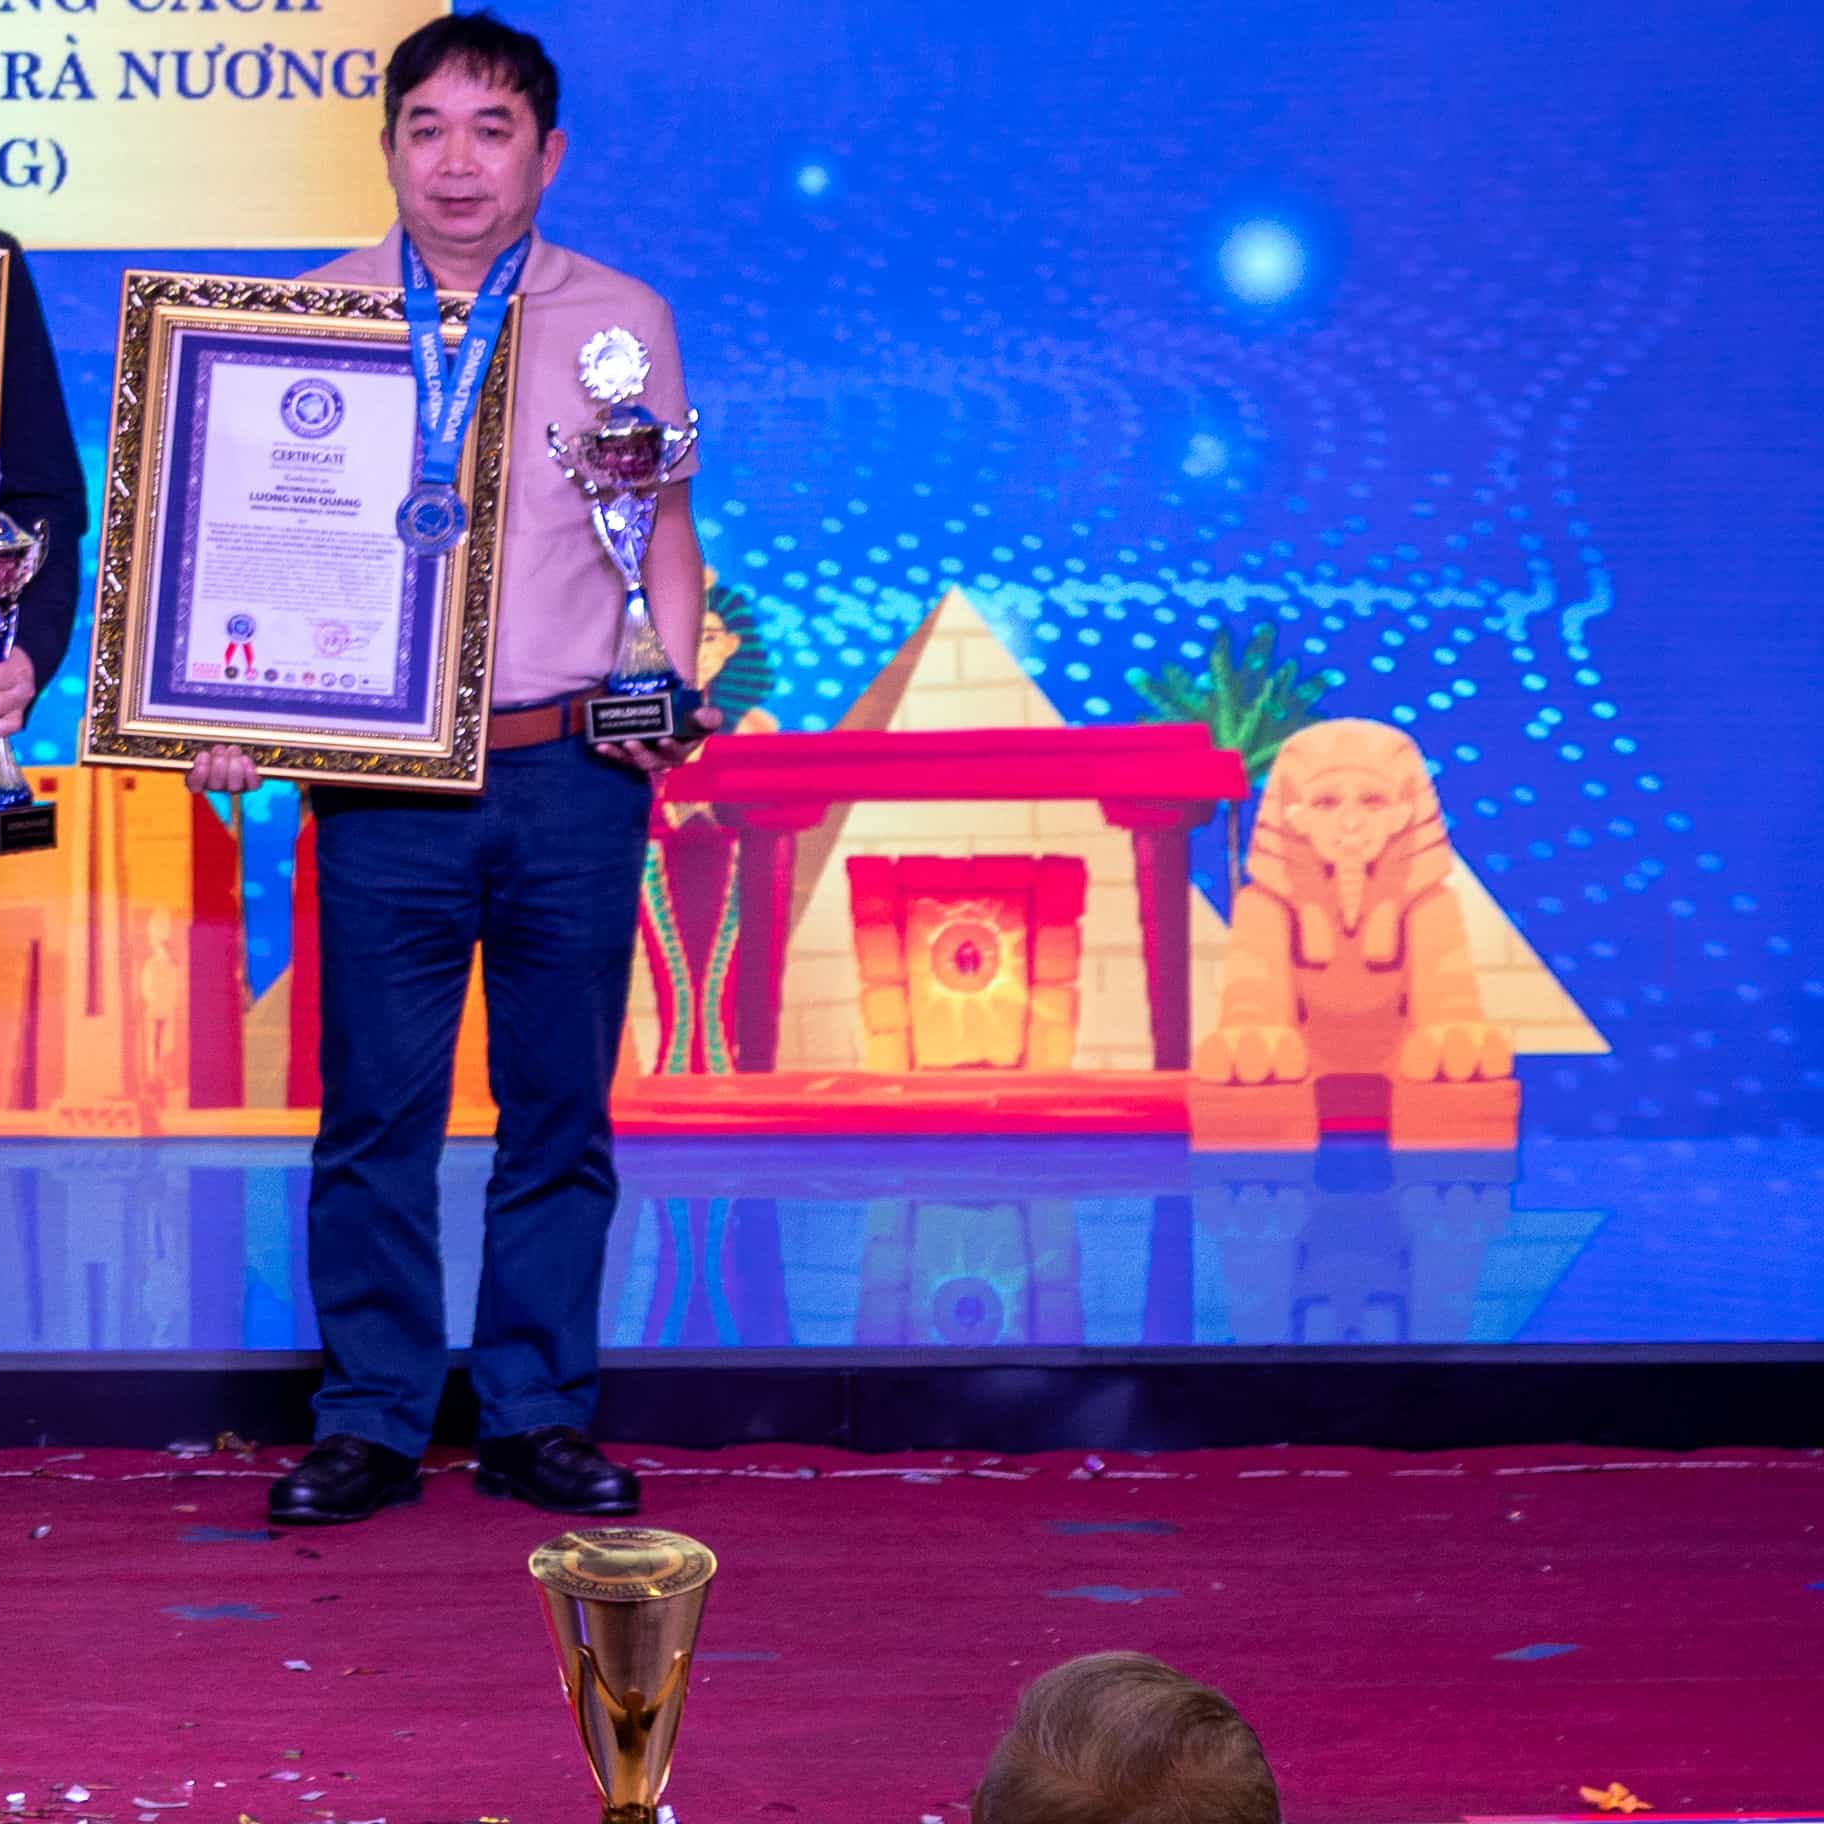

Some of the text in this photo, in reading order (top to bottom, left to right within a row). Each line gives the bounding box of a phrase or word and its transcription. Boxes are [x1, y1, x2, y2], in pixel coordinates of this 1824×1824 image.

[117, 43, 381, 100] NƯƠNG
[440, 338, 487, 443] WORLDKINGS
[248, 492, 363, 509] LUONG VAN QUANG
